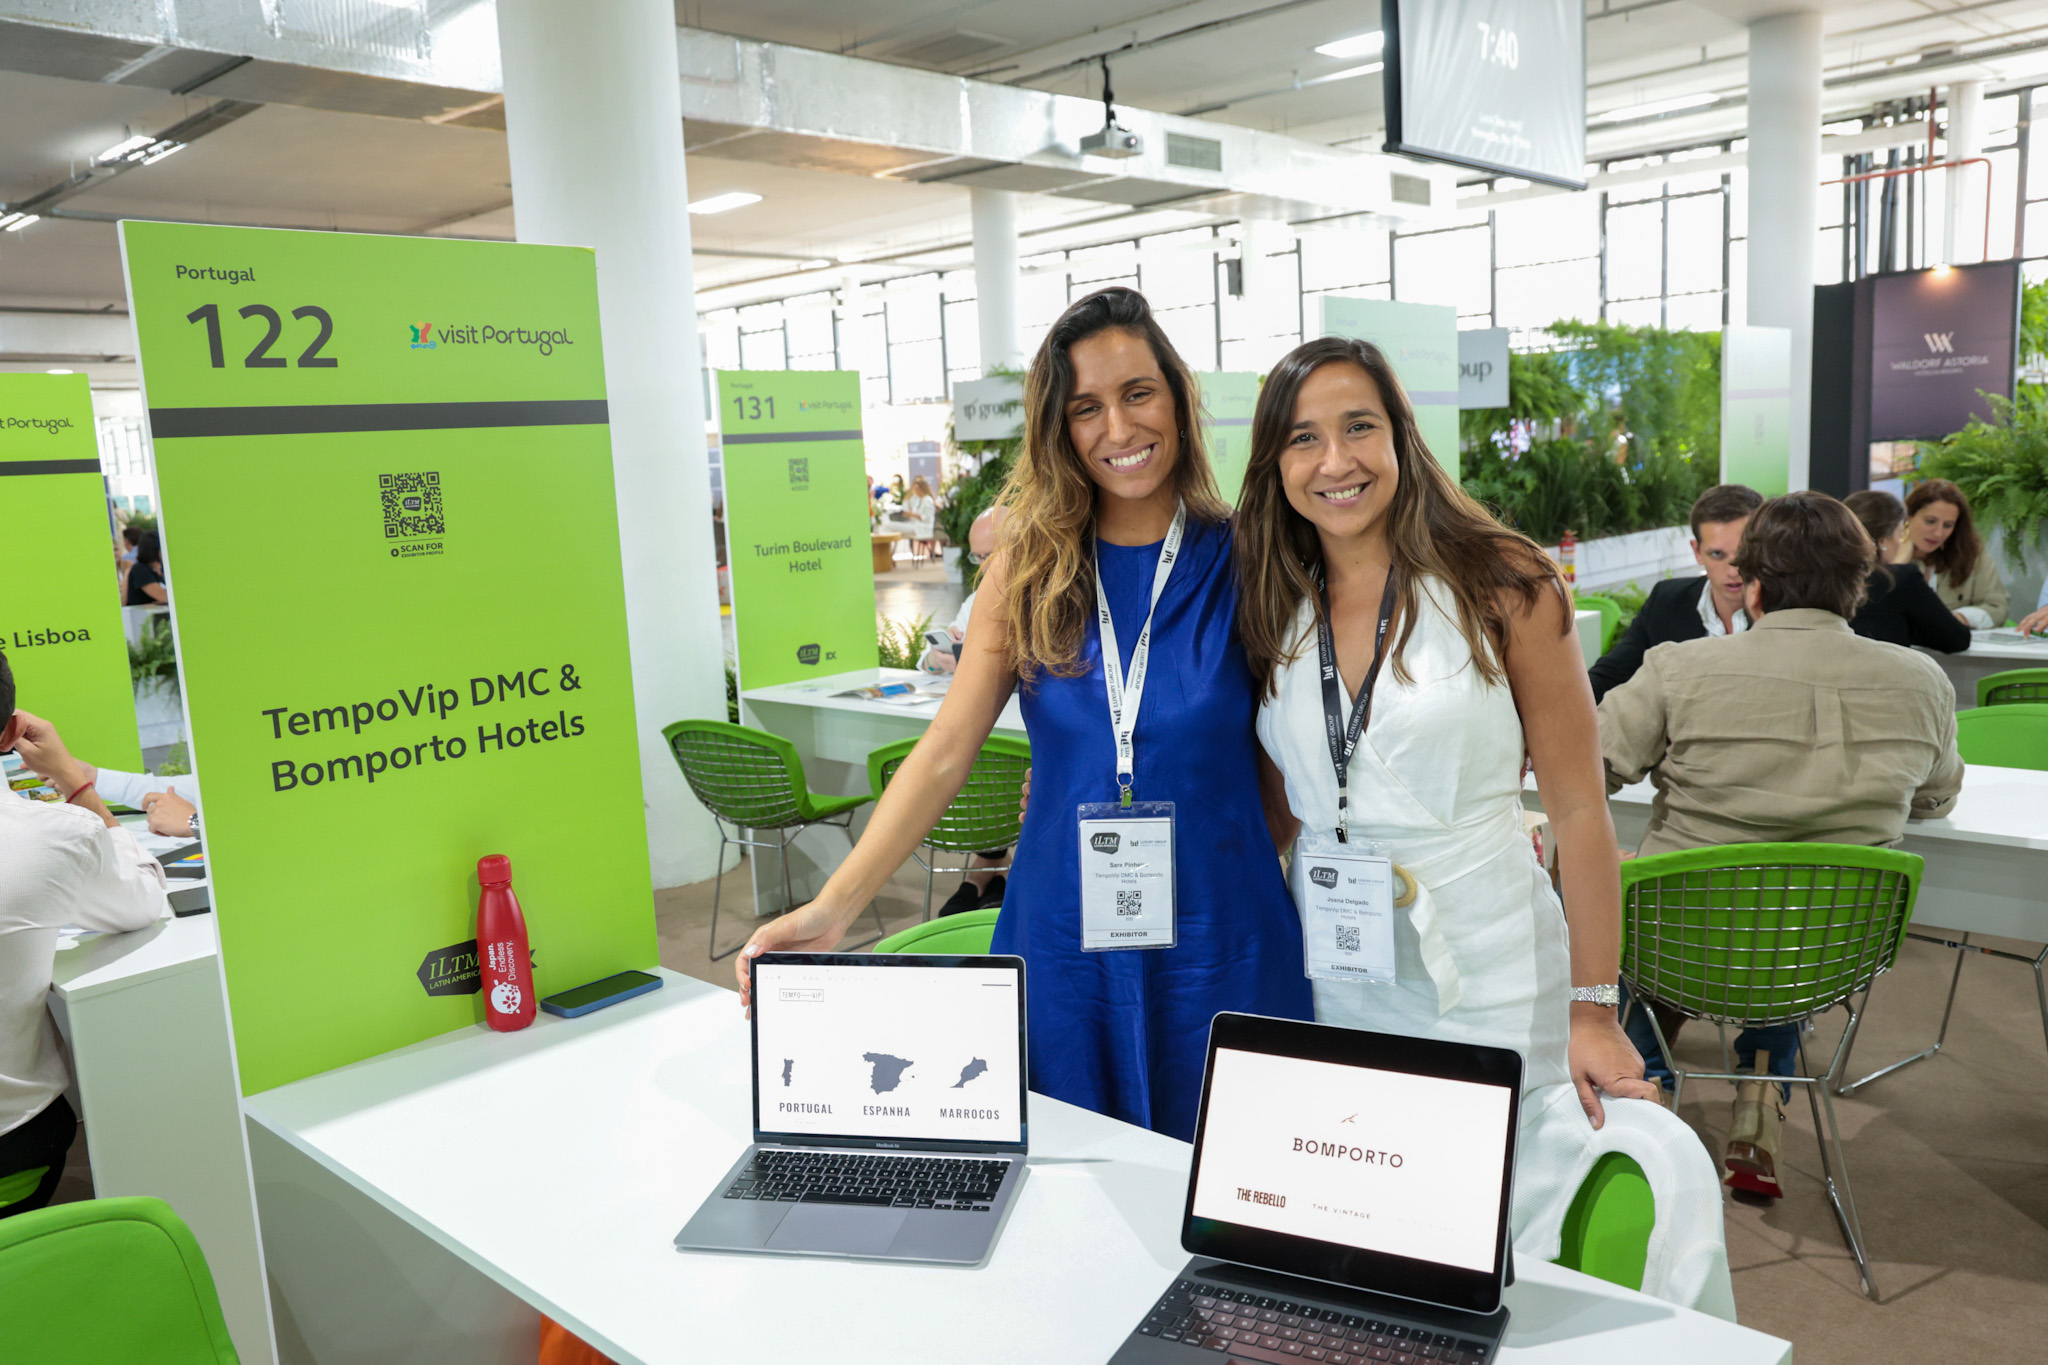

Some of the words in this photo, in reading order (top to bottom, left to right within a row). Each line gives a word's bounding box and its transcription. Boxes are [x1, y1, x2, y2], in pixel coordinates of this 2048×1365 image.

[175, 264, 256, 285] Portugal
[186, 304, 338, 368] 122
[437, 324, 479, 344] visit
[482, 325, 574, 356] Portugal
[733, 396, 775, 420] 131
[7, 417, 74, 435] Portugal
[400, 544, 424, 553] SCAN
[426, 542, 443, 550] FOR
[754, 543, 790, 557] Turim
[793, 536, 852, 553] Boulevard
[789, 557, 822, 573] Hotel
[13, 627, 91, 648] Lisboa
[1107, 663, 1115, 684] GROUP
[1135, 671, 1144, 690] GROUP
[261, 683, 459, 739] TempoVip
[470, 667, 550, 706] DMC
[559, 663, 582, 691] &
[1110, 684, 1119, 708] LUXURY
[1327, 714, 1336, 736] GROUP
[1348, 715, 1361, 738] LUXURY
[1357, 693, 1369, 714] GROUP
[271, 735, 467, 792] Bomporto
[477, 710, 585, 754] Hotels
[1331, 737, 1339, 761] LUXURY
[1345, 898, 1369, 906] Delgado
[487, 943, 497, 971] Japan.
[497, 942, 507, 973] Endless
[506, 940, 517, 981] Discovery.
[1331, 964, 1368, 974] EXHIBITOR
[429, 977, 451, 990] LATIN
[779, 1102, 833, 1114] PORTUGAL
[863, 1105, 911, 1117] ESPANHA
[940, 1108, 1000, 1120] MARROCOS
[1292, 1137, 1404, 1168] BOMPORTO
[1236, 1187, 1252, 1202] THE
[1252, 1190, 1286, 1208] REBELLO
[1312, 1203, 1328, 1211] THE
[1333, 1208, 1371, 1219] VINTAGE
